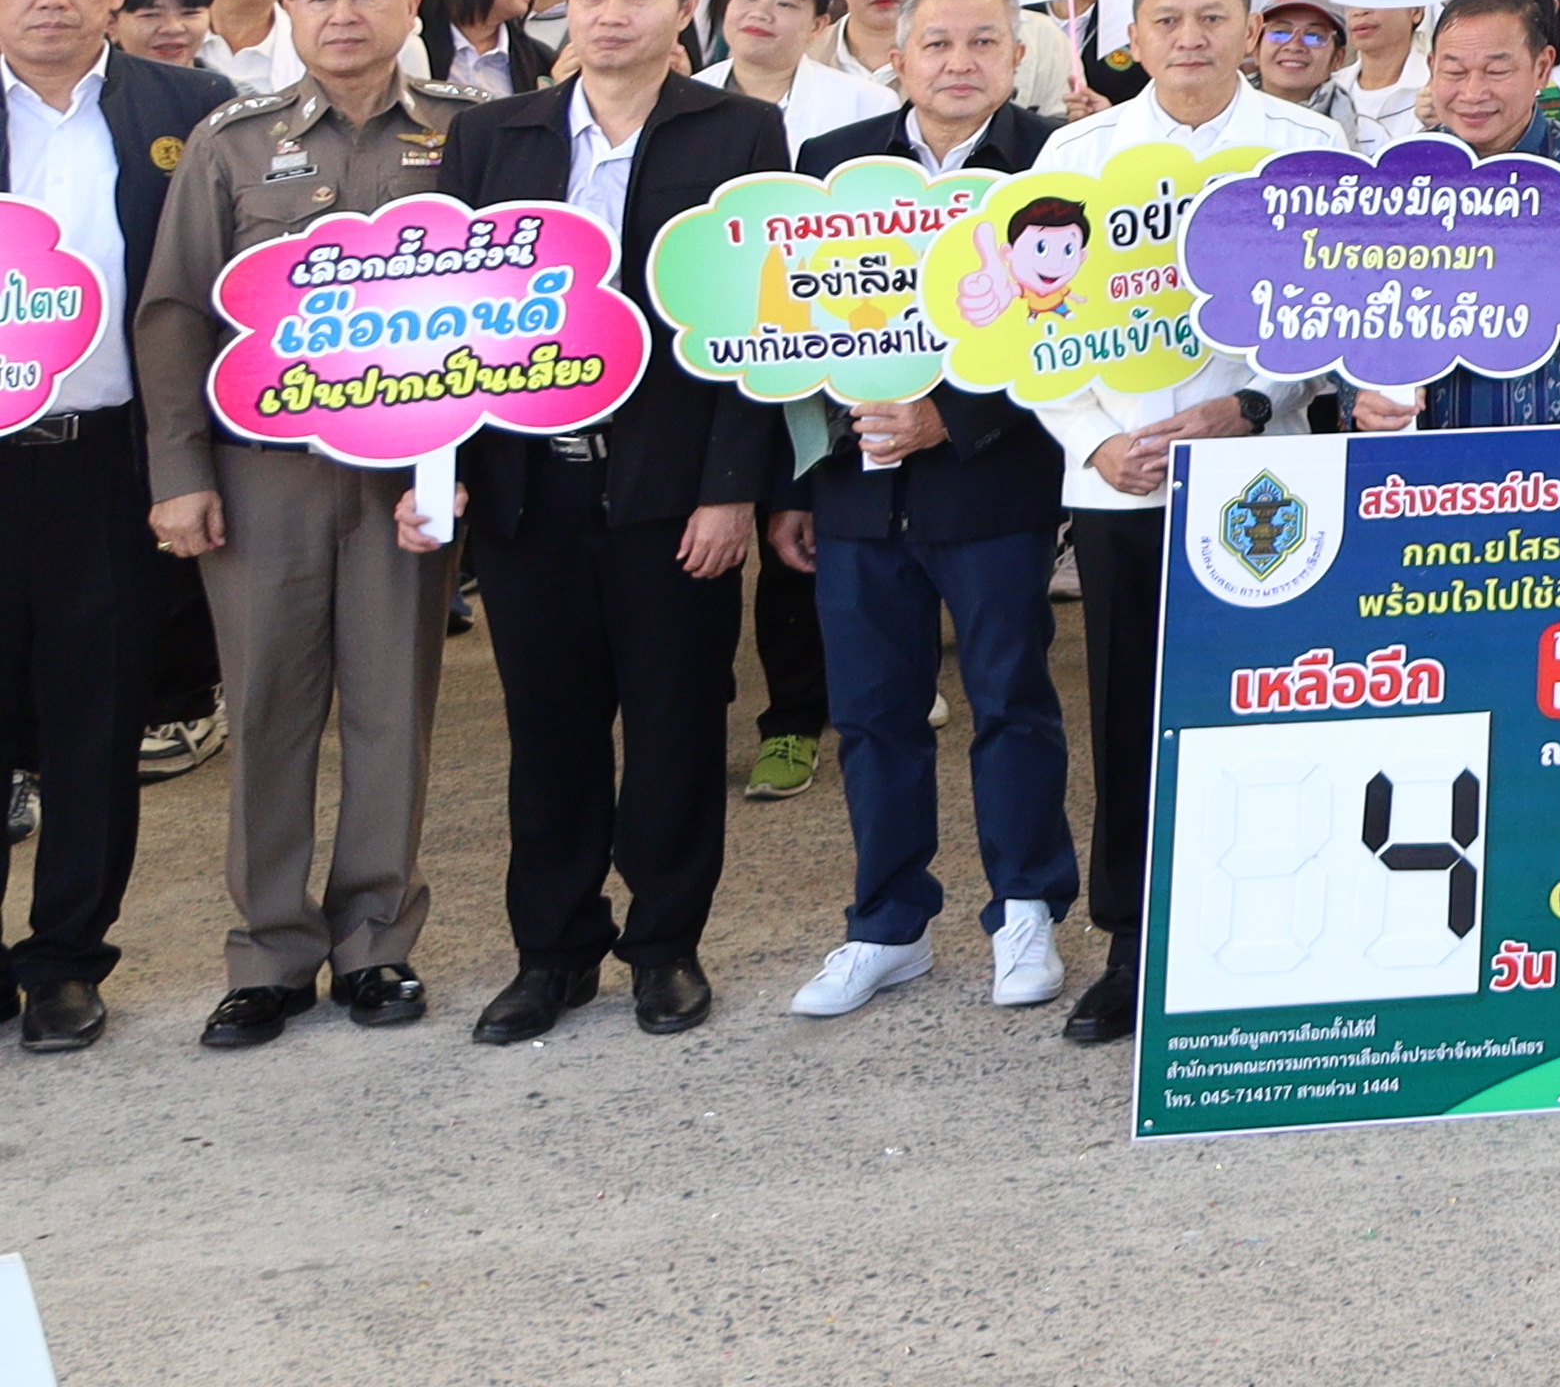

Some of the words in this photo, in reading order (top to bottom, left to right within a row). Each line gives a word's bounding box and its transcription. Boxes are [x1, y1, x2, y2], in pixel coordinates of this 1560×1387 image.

[1263, 172, 1541, 230] ทุกเสียงมีคุณค่า
[290, 219, 541, 285] เลือกตั้งครั้งนี้
[726, 219, 742, 243] 1
[1301, 230, 1495, 271] โปรดออกมา
[275, 272, 570, 355] เลือกคนดี
[260, 345, 603, 415] เป็นปากเป็นเสียง
[1231, 645, 1445, 715] เหลืออีก
[1361, 768, 1480, 941] 4
[1489, 940, 1556, 992] วัน
[1166, 1036, 1545, 1081] สำนักงานคณะกรรมการการเลือกตั้งประจำจังหวัดยโสธร
[1167, 1015, 1378, 1052] สอบถามข้อมูลการเลือกตั้งได้ที่
[1164, 1089, 1196, 1108] โทร.
[1200, 1085, 1293, 1107] 045-714177
[1297, 1079, 1357, 1100] สายด่วน
[1362, 1076, 1400, 1095] 1444
